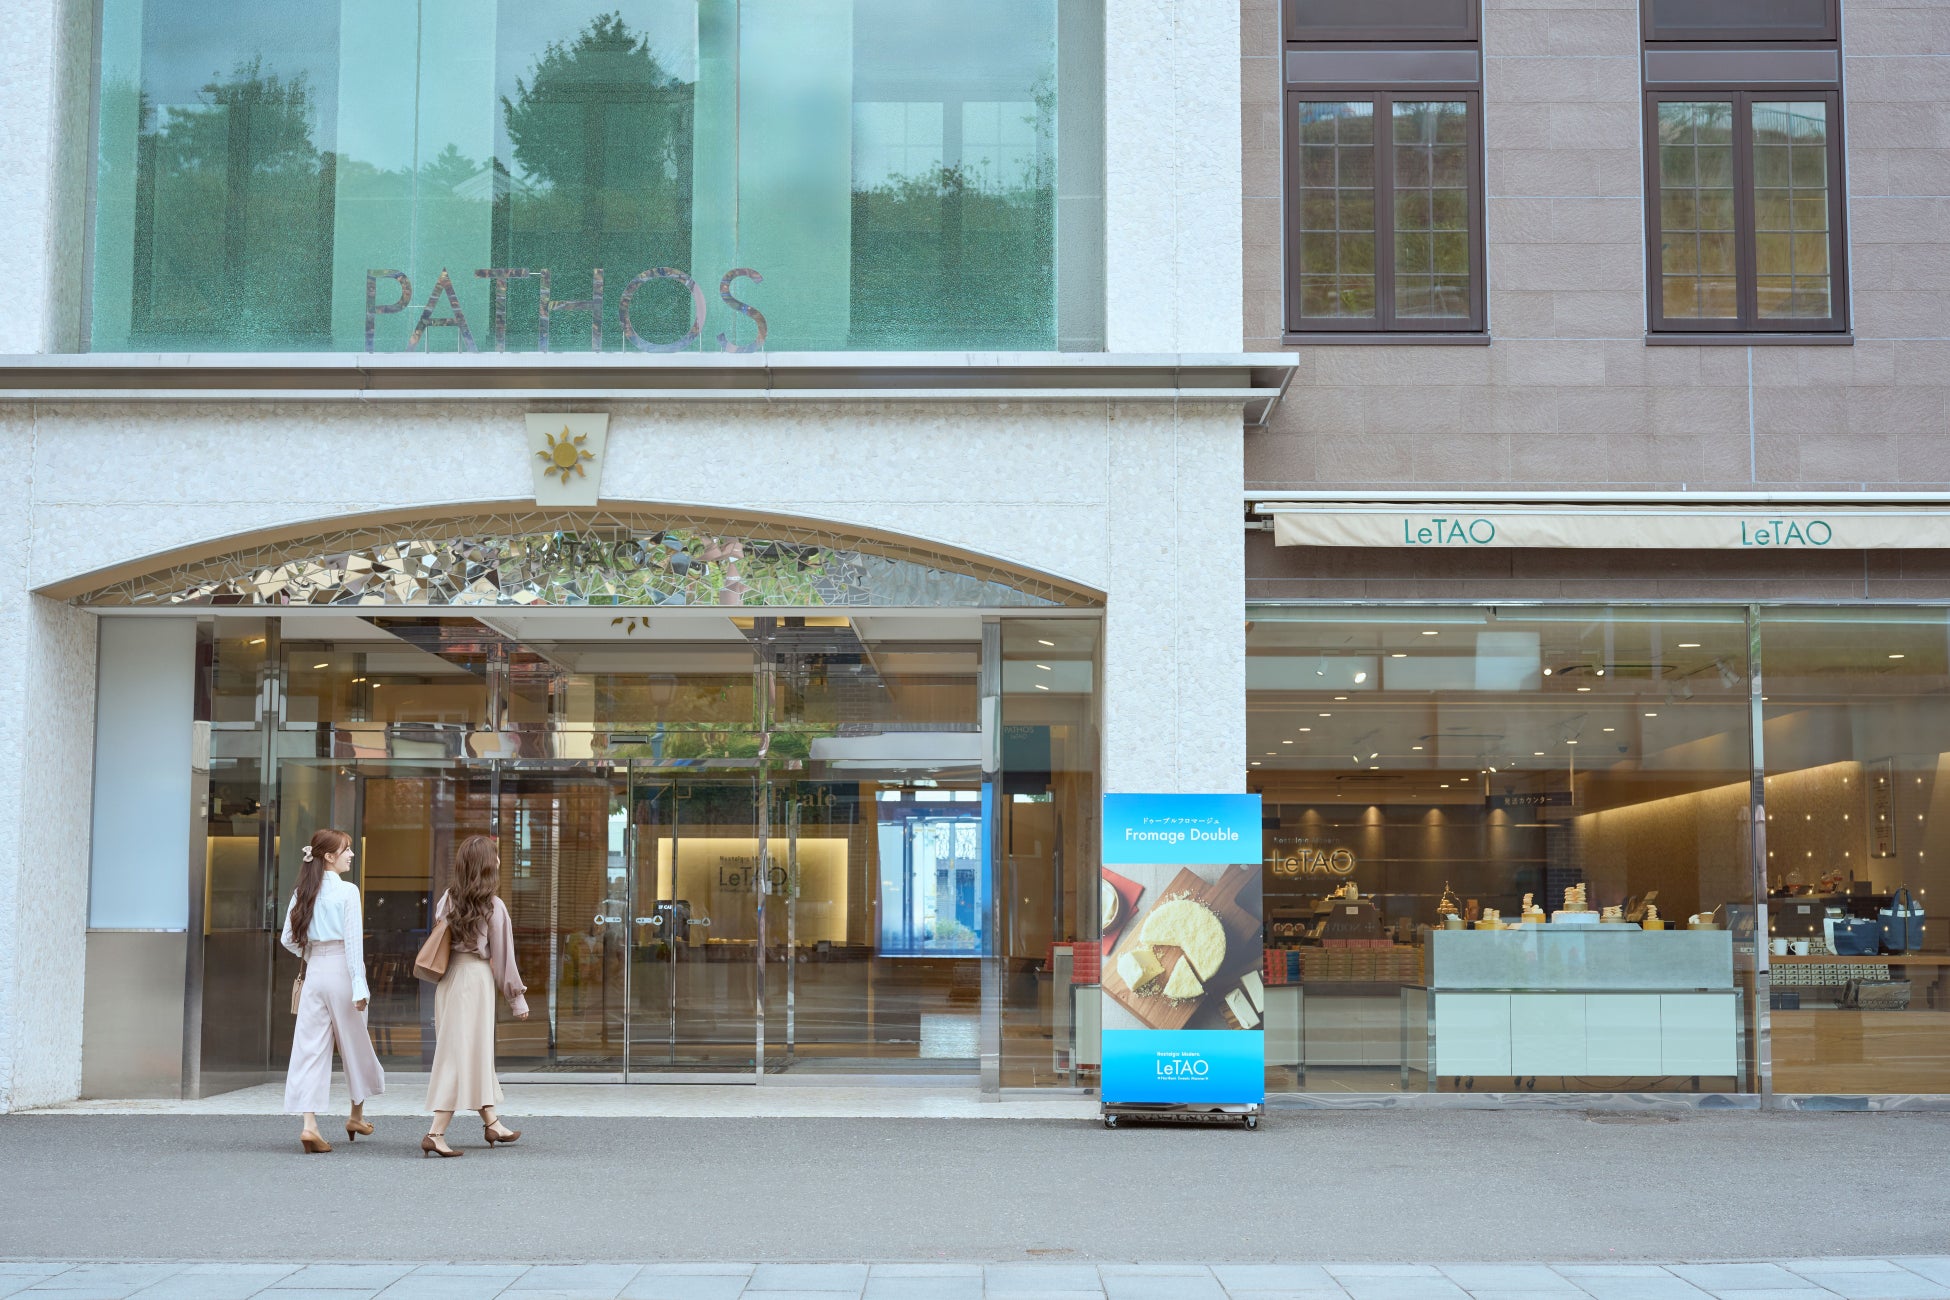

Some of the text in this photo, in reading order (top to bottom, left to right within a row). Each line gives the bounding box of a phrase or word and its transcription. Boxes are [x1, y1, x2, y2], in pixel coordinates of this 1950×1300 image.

[365, 266, 768, 353] PATHOS
[1404, 518, 1495, 544] LeTAO
[1741, 520, 1832, 545] LeTAO
[1143, 817, 1220, 825] ドゥーブルフロマージュ
[1125, 827, 1239, 845] Fromage Double
[1274, 848, 1355, 873] LeTAO
[1156, 1059, 1209, 1075] LeTAO
